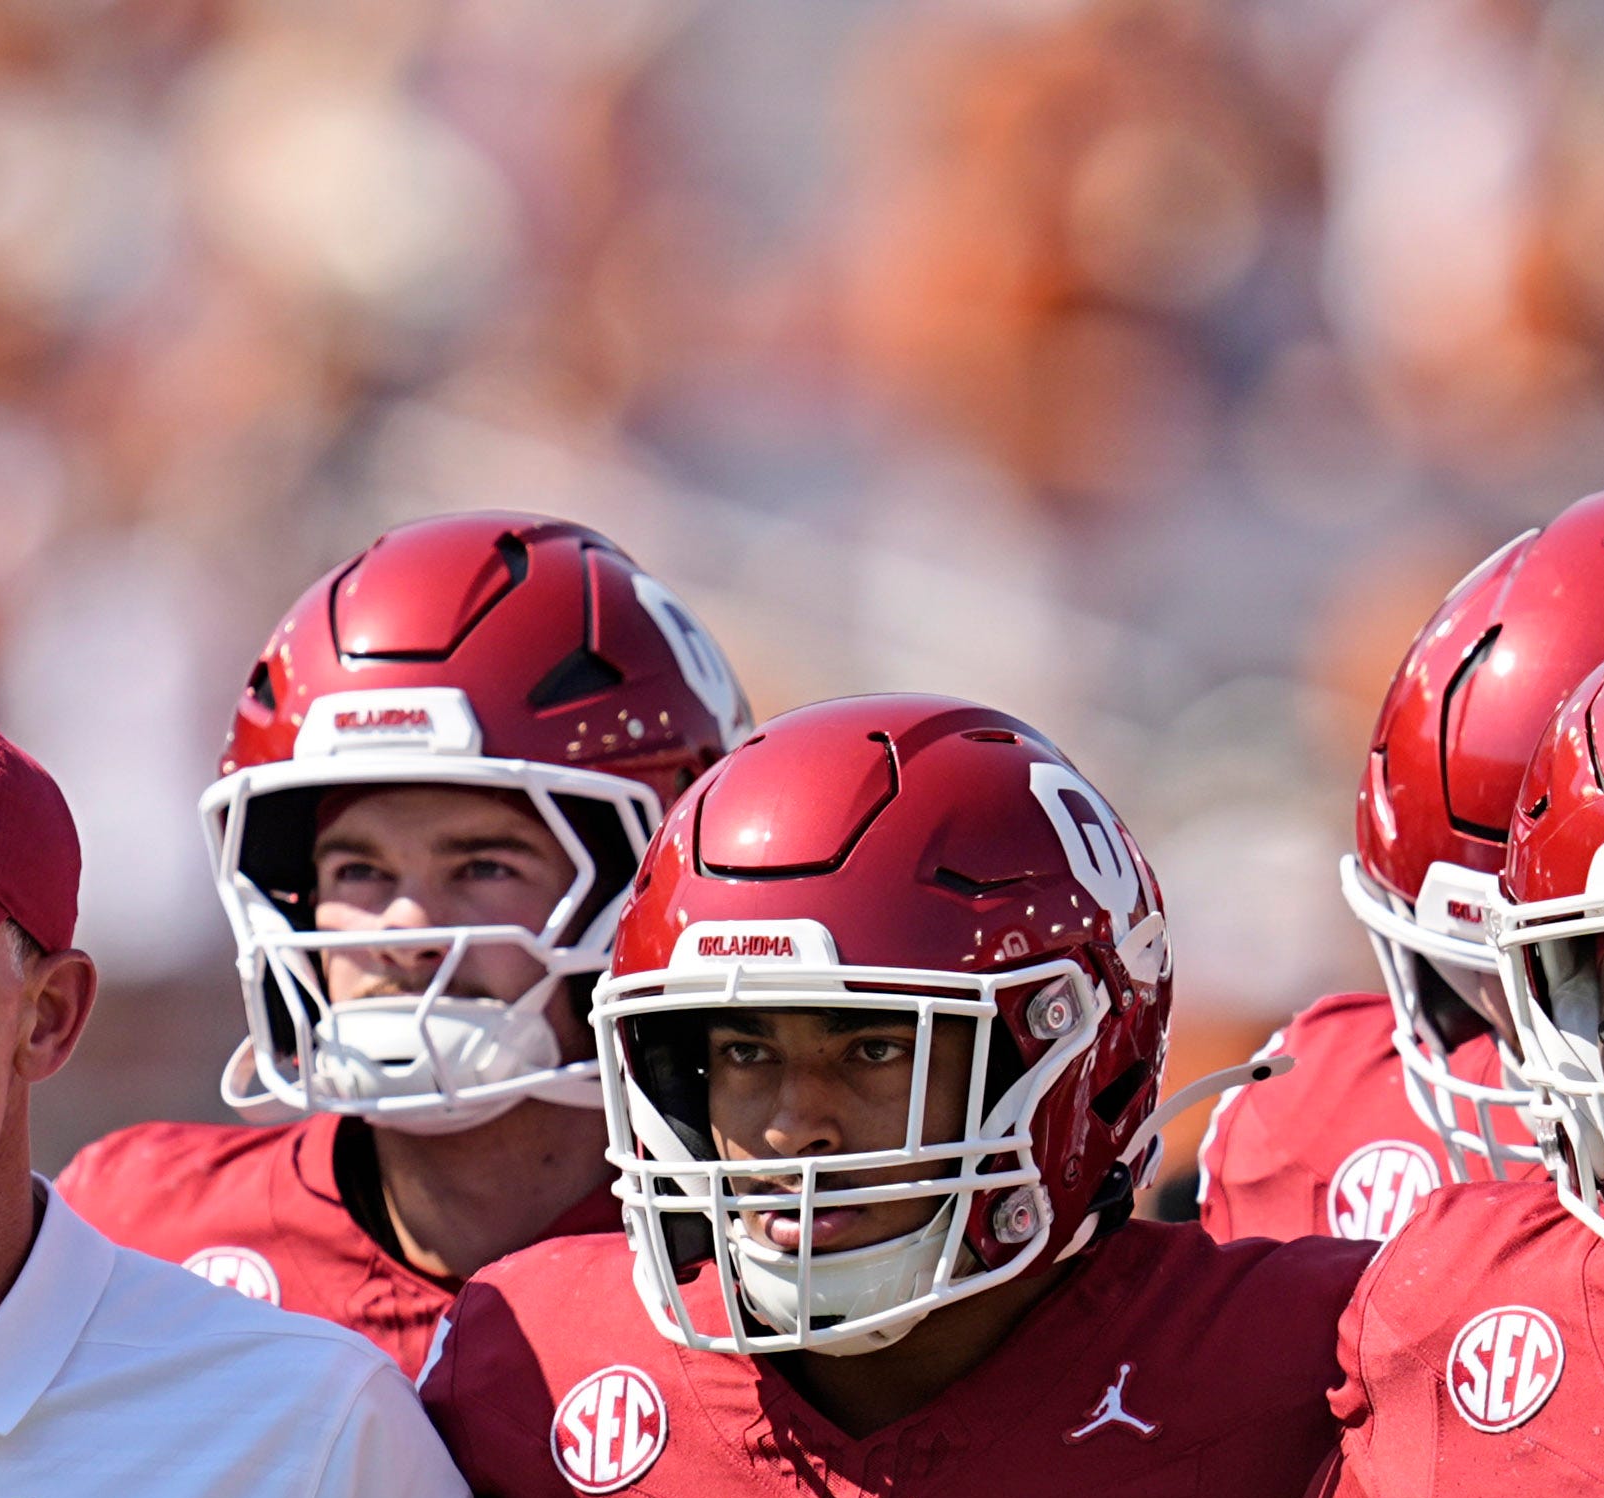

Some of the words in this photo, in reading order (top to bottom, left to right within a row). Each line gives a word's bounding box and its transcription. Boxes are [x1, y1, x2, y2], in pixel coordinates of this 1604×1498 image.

[698, 935, 793, 956] OKLAHOMA
[1458, 1313, 1554, 1423] SEC
[562, 1375, 655, 1483] SEC
